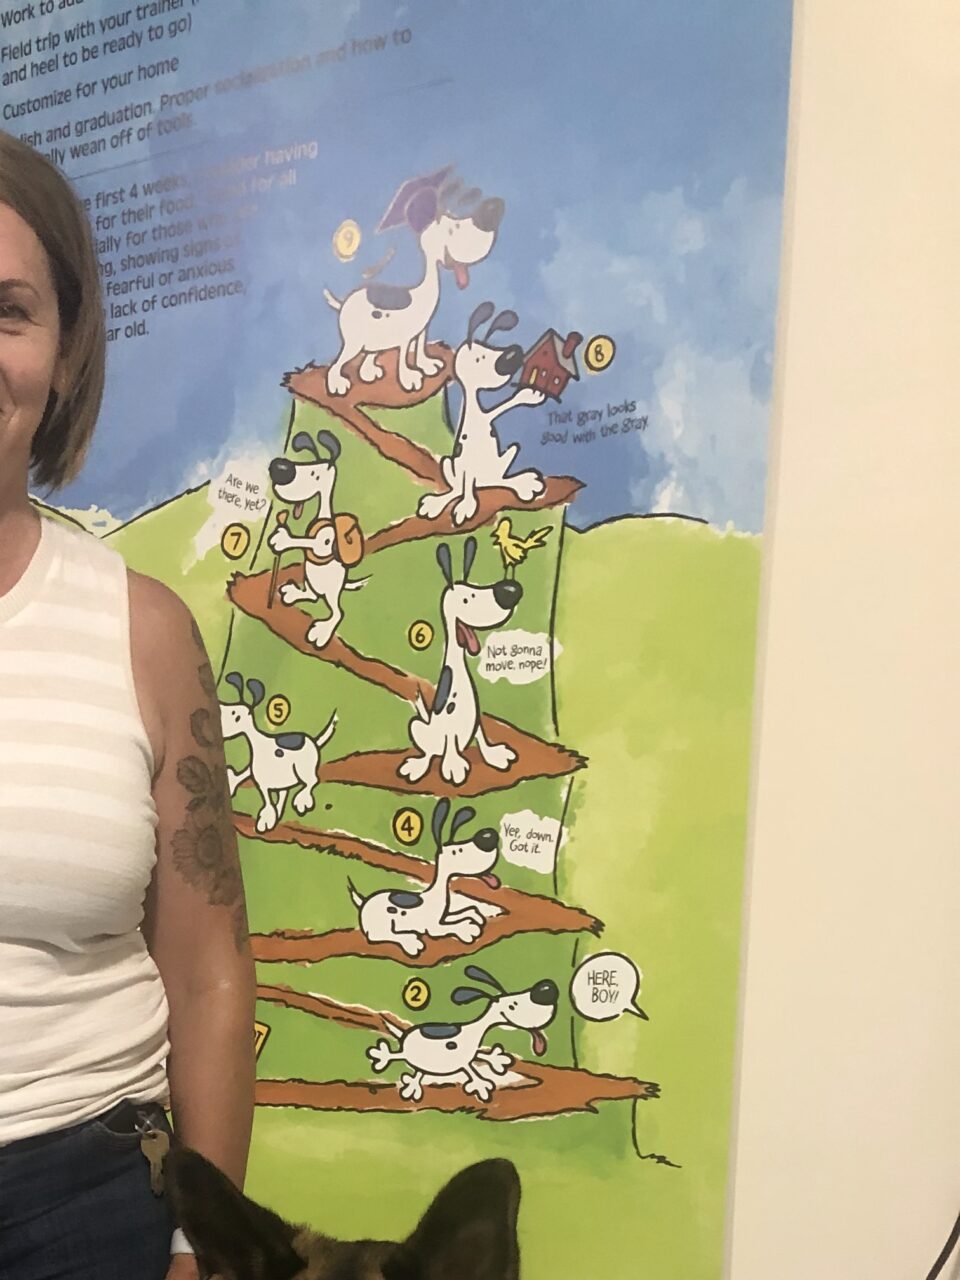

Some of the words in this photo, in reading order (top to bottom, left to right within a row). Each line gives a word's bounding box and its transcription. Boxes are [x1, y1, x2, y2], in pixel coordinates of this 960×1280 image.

[0, 4, 35, 28] Work
[40, 0, 54, 16] to
[1, 39, 31, 63] Field
[35, 32, 60, 52] trip
[64, 20, 95, 43] with
[99, 10, 132, 34] your
[2, 64, 27, 86] and
[31, 54, 58, 78] heel
[63, 51, 77, 67] to
[81, 45, 99, 62] be
[103, 30, 143, 55] ready
[148, 24, 163, 41] to
[168, 12, 192, 38] go)
[3, 88, 72, 120] Customize
[76, 80, 97, 98] for
[101, 70, 133, 94] your
[137, 56, 179, 81] home
[45, 120, 70, 143] and
[160, 85, 209, 111] Proper
[351, 34, 388, 55] how
[392, 28, 412, 46] to
[70, 138, 106, 159] wean
[110, 127, 133, 148] off
[136, 121, 153, 141] of
[95, 187, 125, 209] first
[129, 183, 138, 199] 4
[265, 141, 318, 165] having
[95, 215, 117, 232] for
[121, 203, 155, 226] their
[126, 230, 147, 247] for
[120, 247, 179, 272] showing
[106, 272, 154, 296] fearful
[159, 271, 173, 286] or
[110, 299, 137, 319] lack
[141, 294, 157, 313] of
[161, 280, 247, 309] confidence,
[124, 319, 149, 339] old.
[595, 344, 605, 363] 8
[548, 410, 572, 426] That
[576, 409, 603, 427] gray
[606, 399, 637, 418] looks
[540, 429, 568, 446] good
[573, 429, 596, 444] with
[600, 421, 619, 438] the
[225, 473, 242, 489] Are
[245, 481, 260, 495] we
[244, 498, 267, 511] yet?
[230, 532, 242, 551] 7
[415, 626, 426, 644] 6
[487, 645, 507, 659] Not
[510, 644, 543, 657] gonna
[518, 658, 548, 673] nope!
[273, 702, 283, 718] 5
[400, 815, 414, 837] 4
[526, 828, 554, 843] down.
[509, 839, 529, 853] Got
[587, 970, 619, 987] HERE,
[410, 985, 421, 1002] 2
[591, 987, 620, 1004] BOY!
